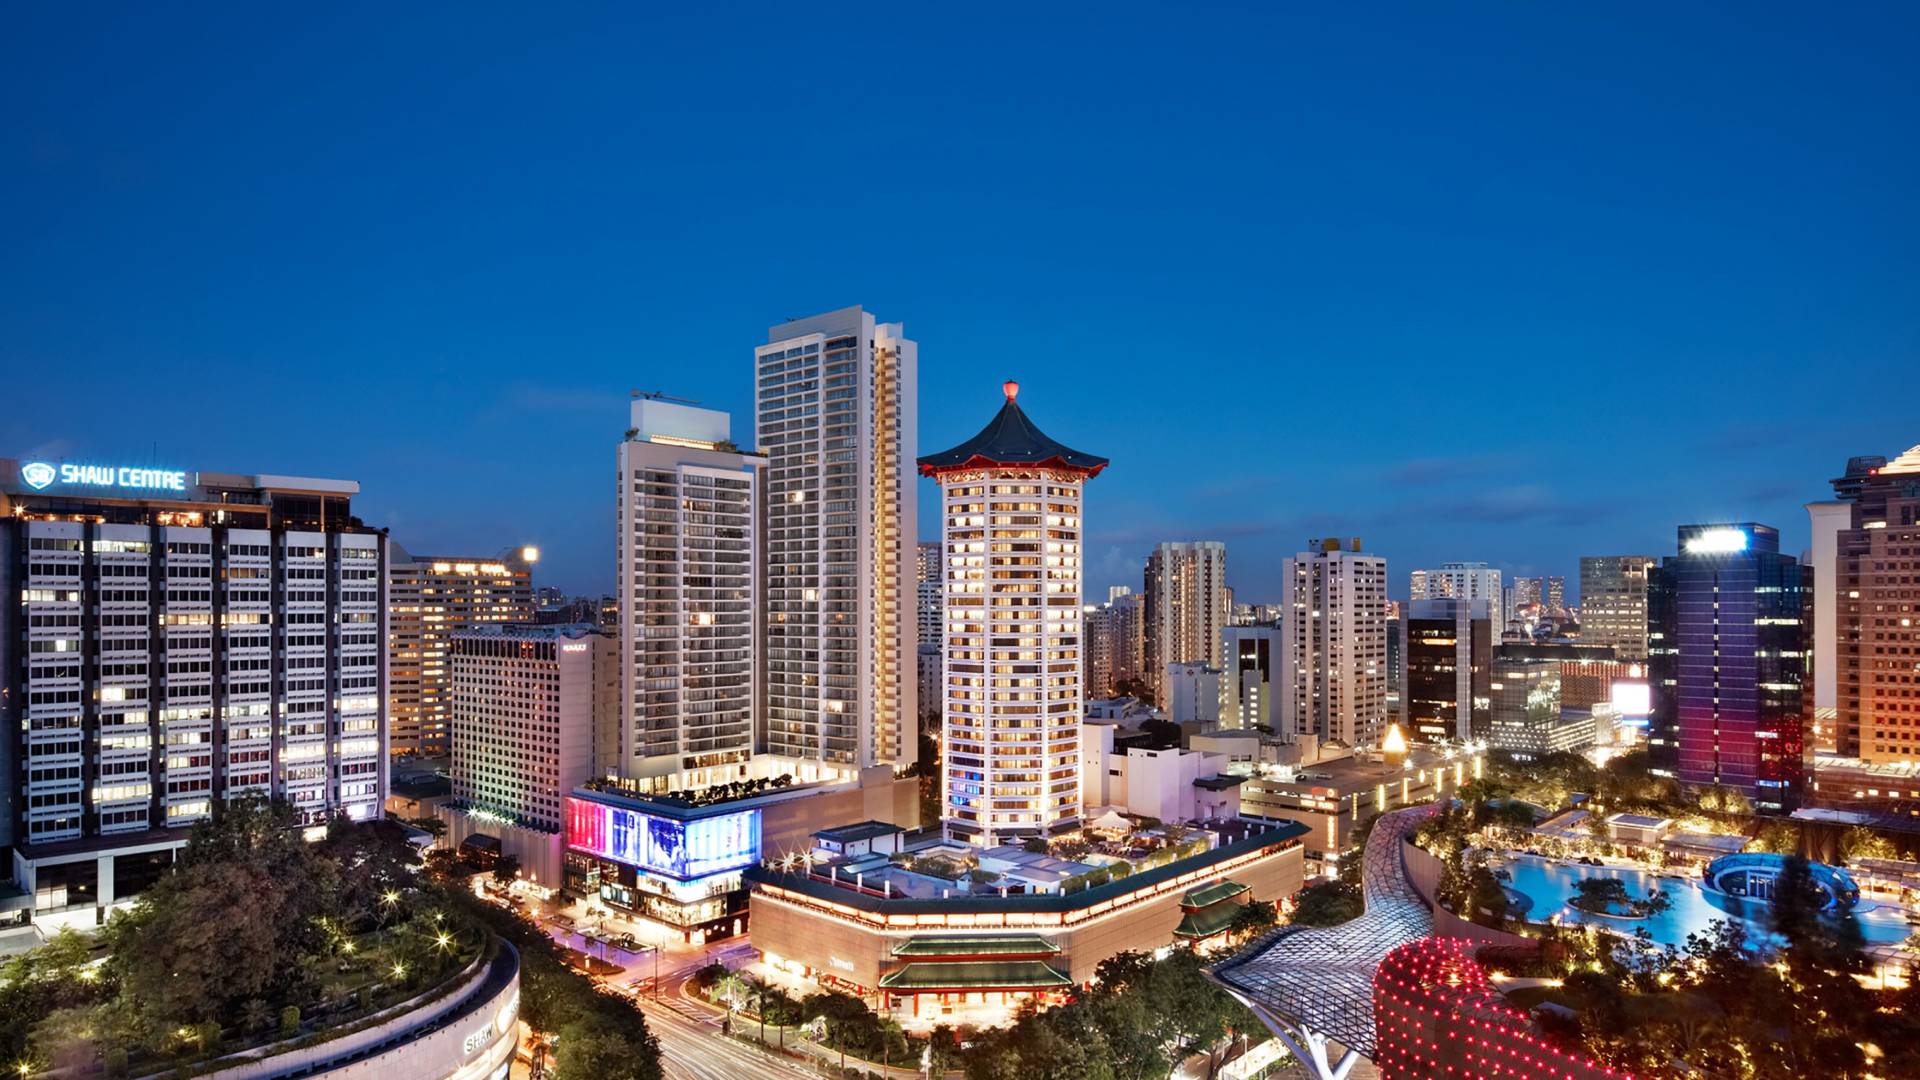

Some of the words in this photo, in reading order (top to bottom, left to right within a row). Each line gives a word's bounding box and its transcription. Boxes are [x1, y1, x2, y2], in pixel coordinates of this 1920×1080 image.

[61, 464, 114, 485] SHAW
[118, 467, 186, 490] CENTRE
[466, 1024, 493, 1052] SHAW
